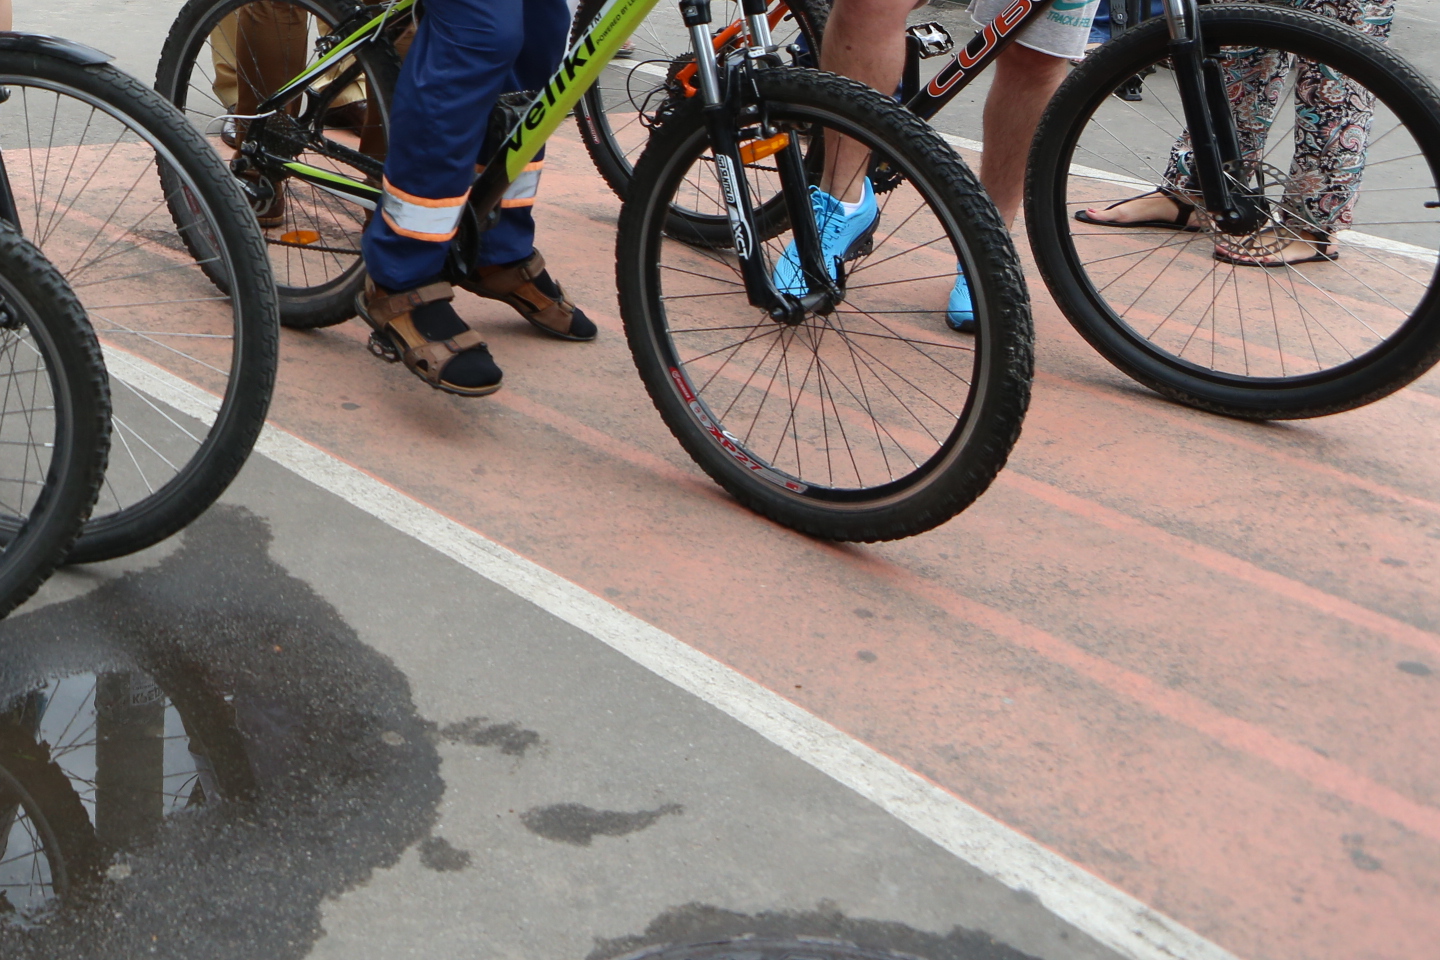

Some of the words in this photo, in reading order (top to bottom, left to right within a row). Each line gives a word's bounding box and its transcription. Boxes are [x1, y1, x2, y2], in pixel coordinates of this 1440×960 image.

[596, 14, 622, 46] POWERED
[620, 6, 629, 16] BY
[507, 28, 596, 152] veliki
